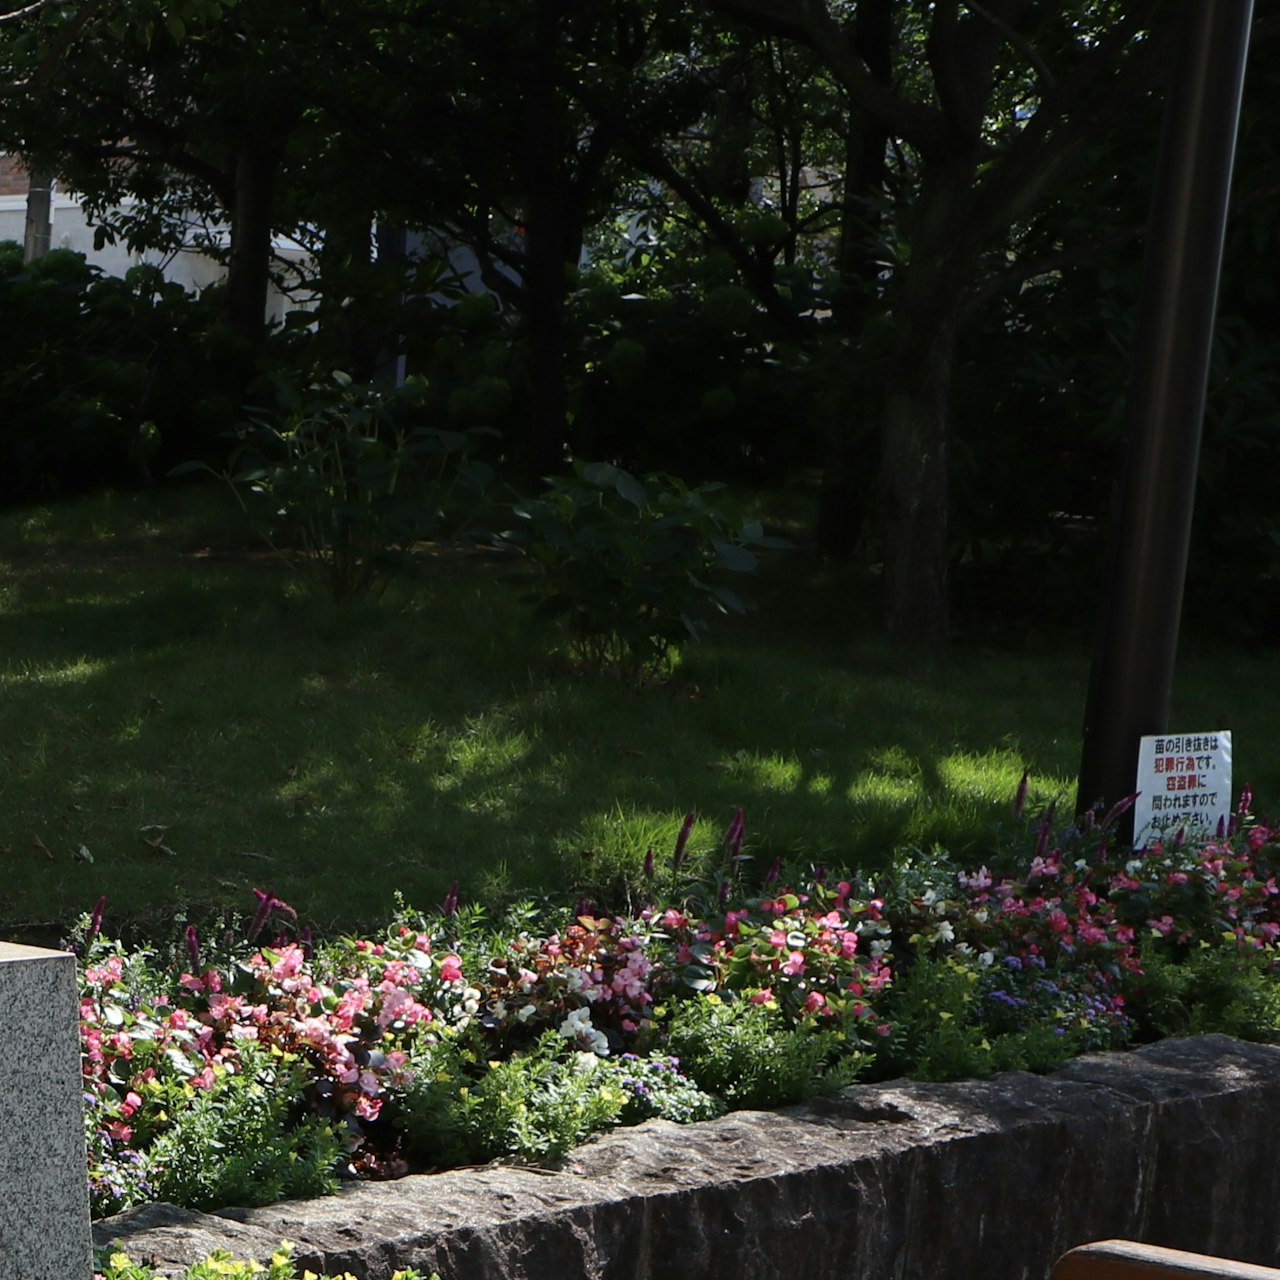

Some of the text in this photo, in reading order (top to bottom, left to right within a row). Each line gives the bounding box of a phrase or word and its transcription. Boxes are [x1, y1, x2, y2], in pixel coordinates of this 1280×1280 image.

[1154, 736, 1219, 754] 苗の引き抜きは
[1154, 755, 1216, 773] 犯罪行為です。
[1166, 774, 1207, 791] 窃盗罪に
[1152, 792, 1218, 810] 問われますので
